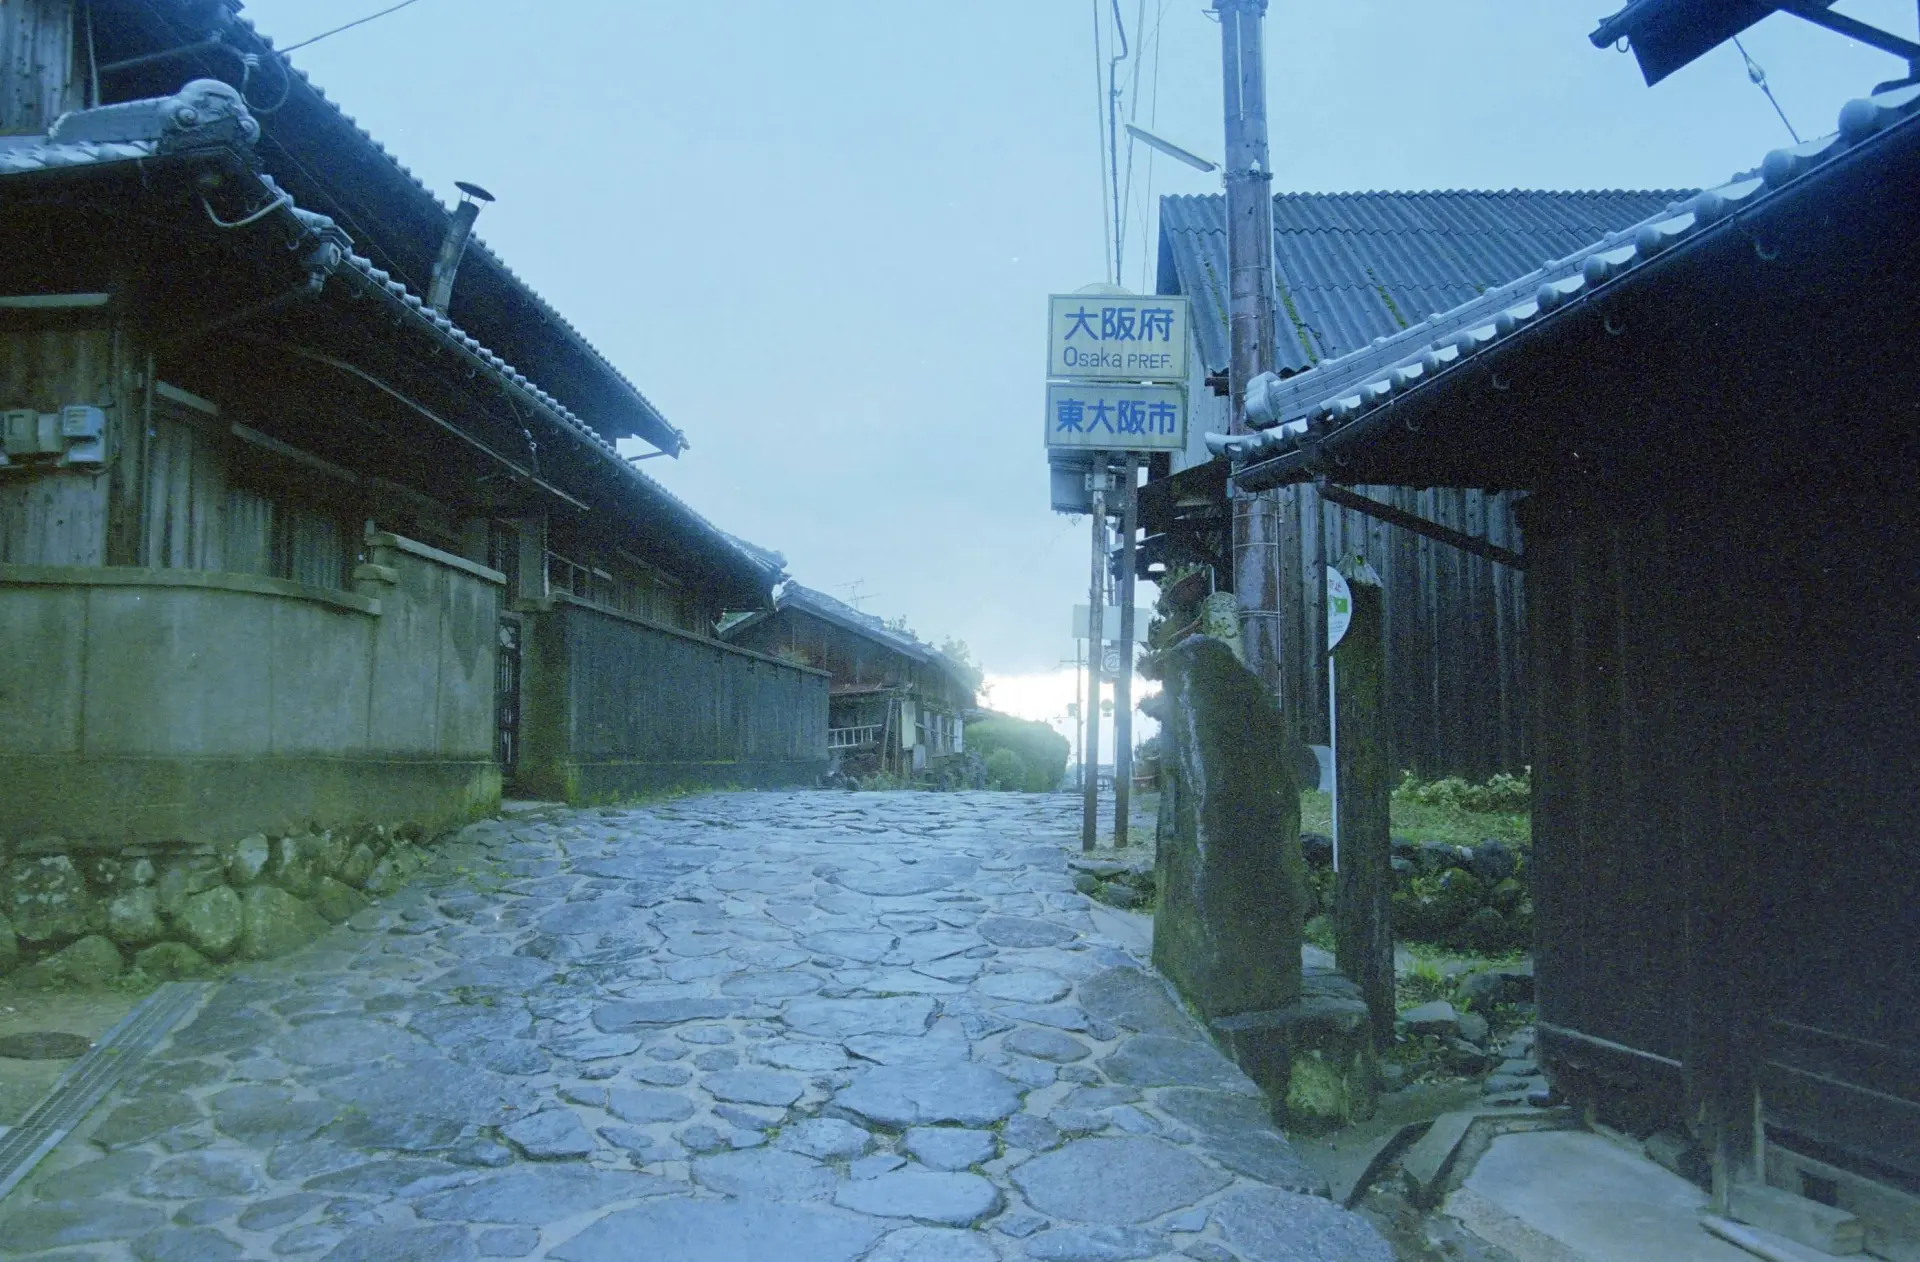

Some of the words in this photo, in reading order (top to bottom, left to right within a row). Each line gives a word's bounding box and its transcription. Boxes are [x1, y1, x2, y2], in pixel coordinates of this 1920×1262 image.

[1064, 306, 1174, 342] 大阪府
[1063, 347, 1122, 368] Osaka
[1127, 353, 1173, 369] PREF.
[1056, 398, 1177, 435] 東大阪市
